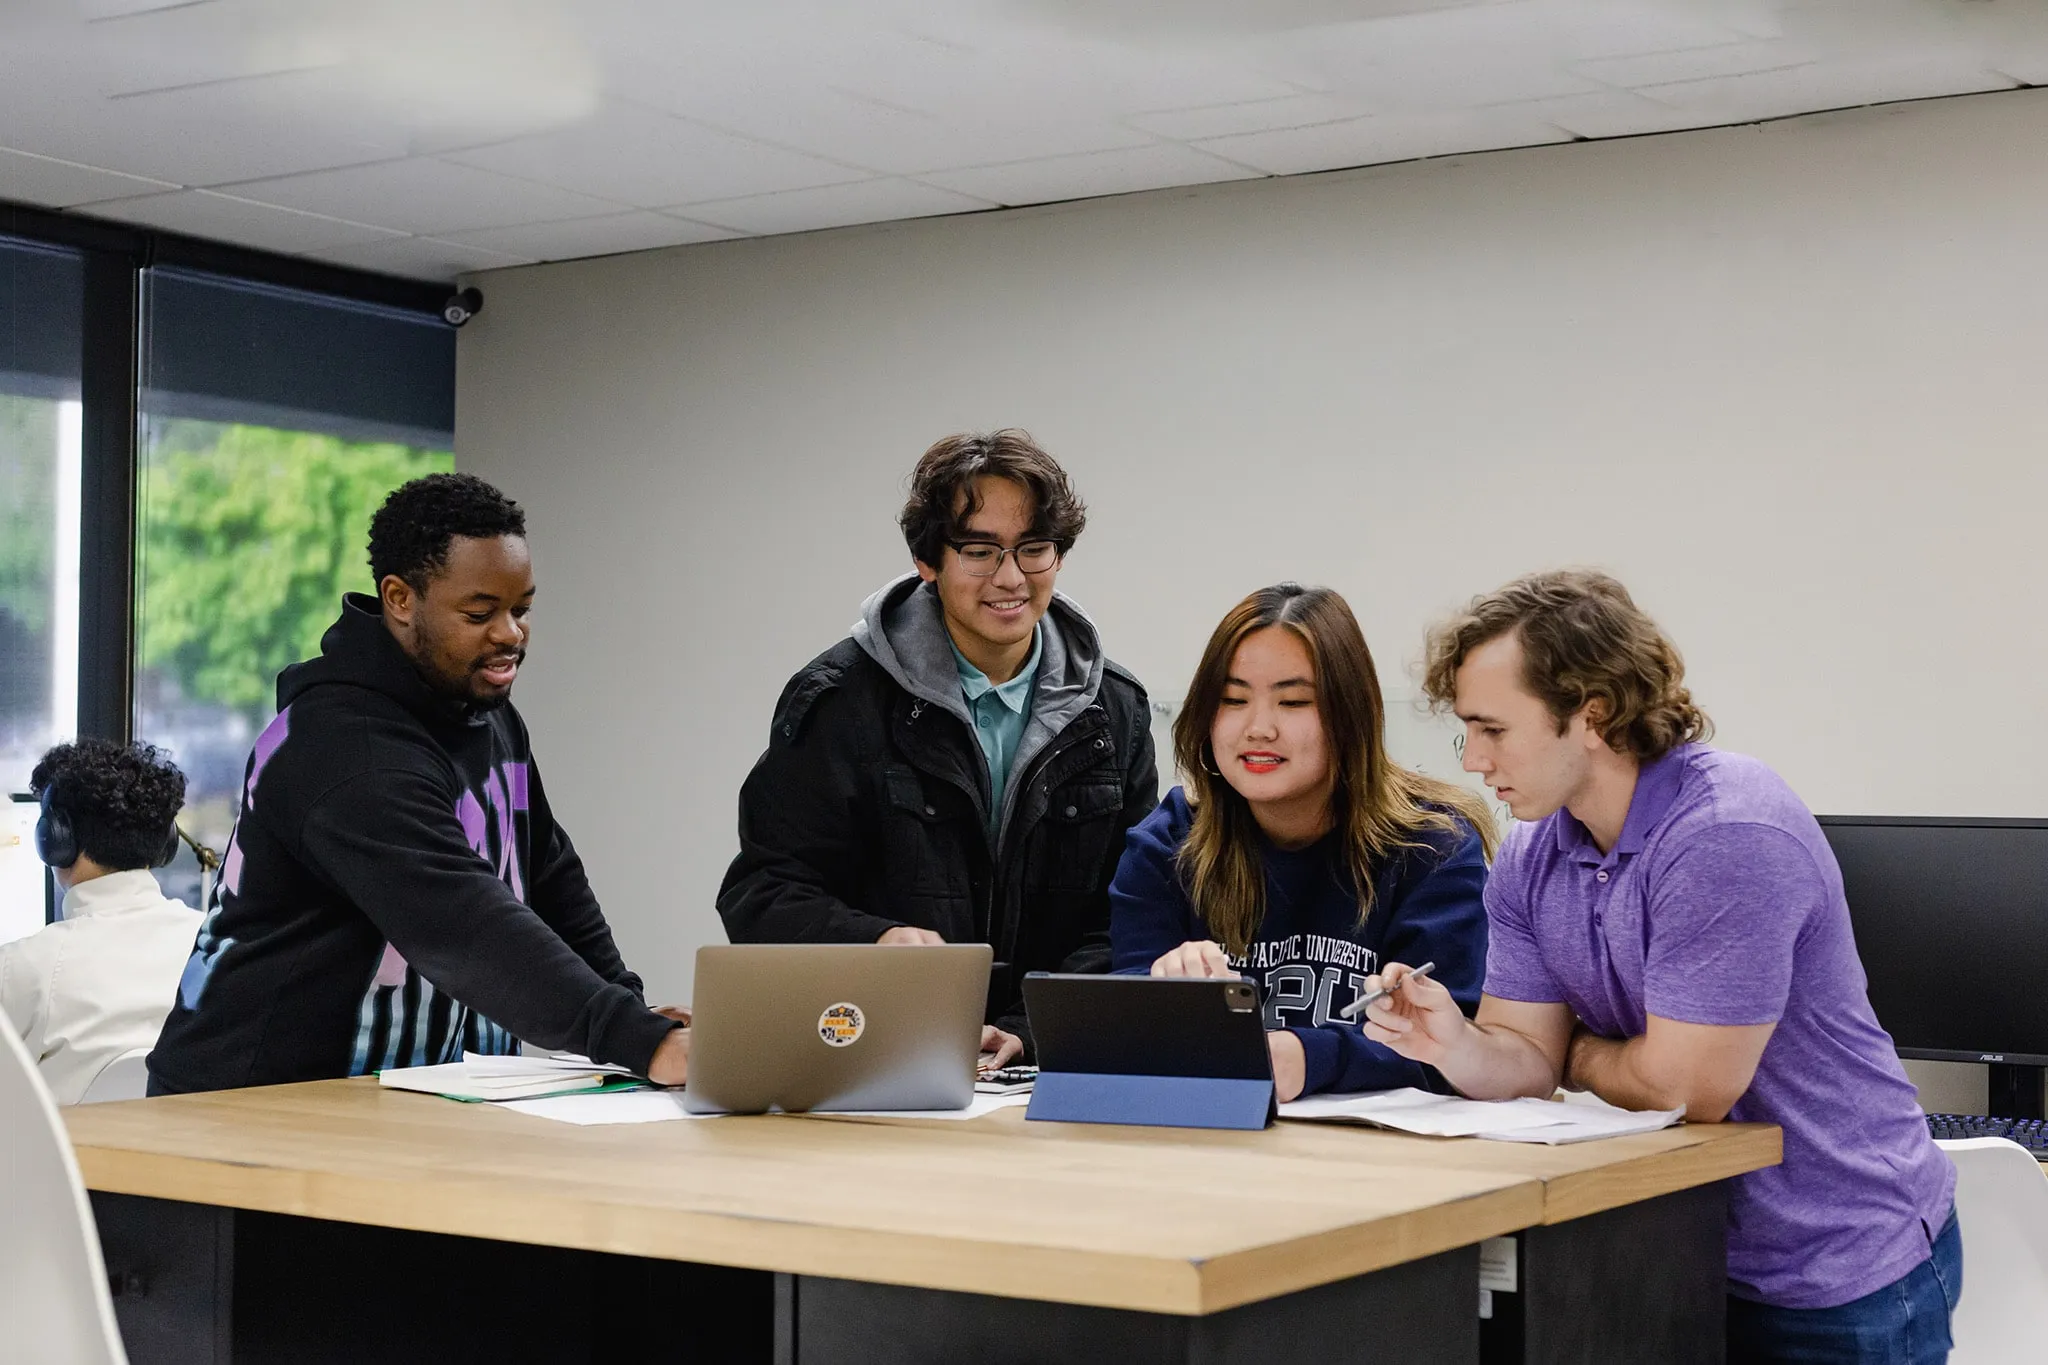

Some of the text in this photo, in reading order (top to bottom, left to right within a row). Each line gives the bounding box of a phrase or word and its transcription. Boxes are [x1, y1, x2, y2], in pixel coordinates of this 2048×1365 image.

[1251, 934, 1301, 969] PACIFIC
[1306, 933, 1379, 974] UNIVERSITY
[1980, 1054, 2004, 1062] ASUS
